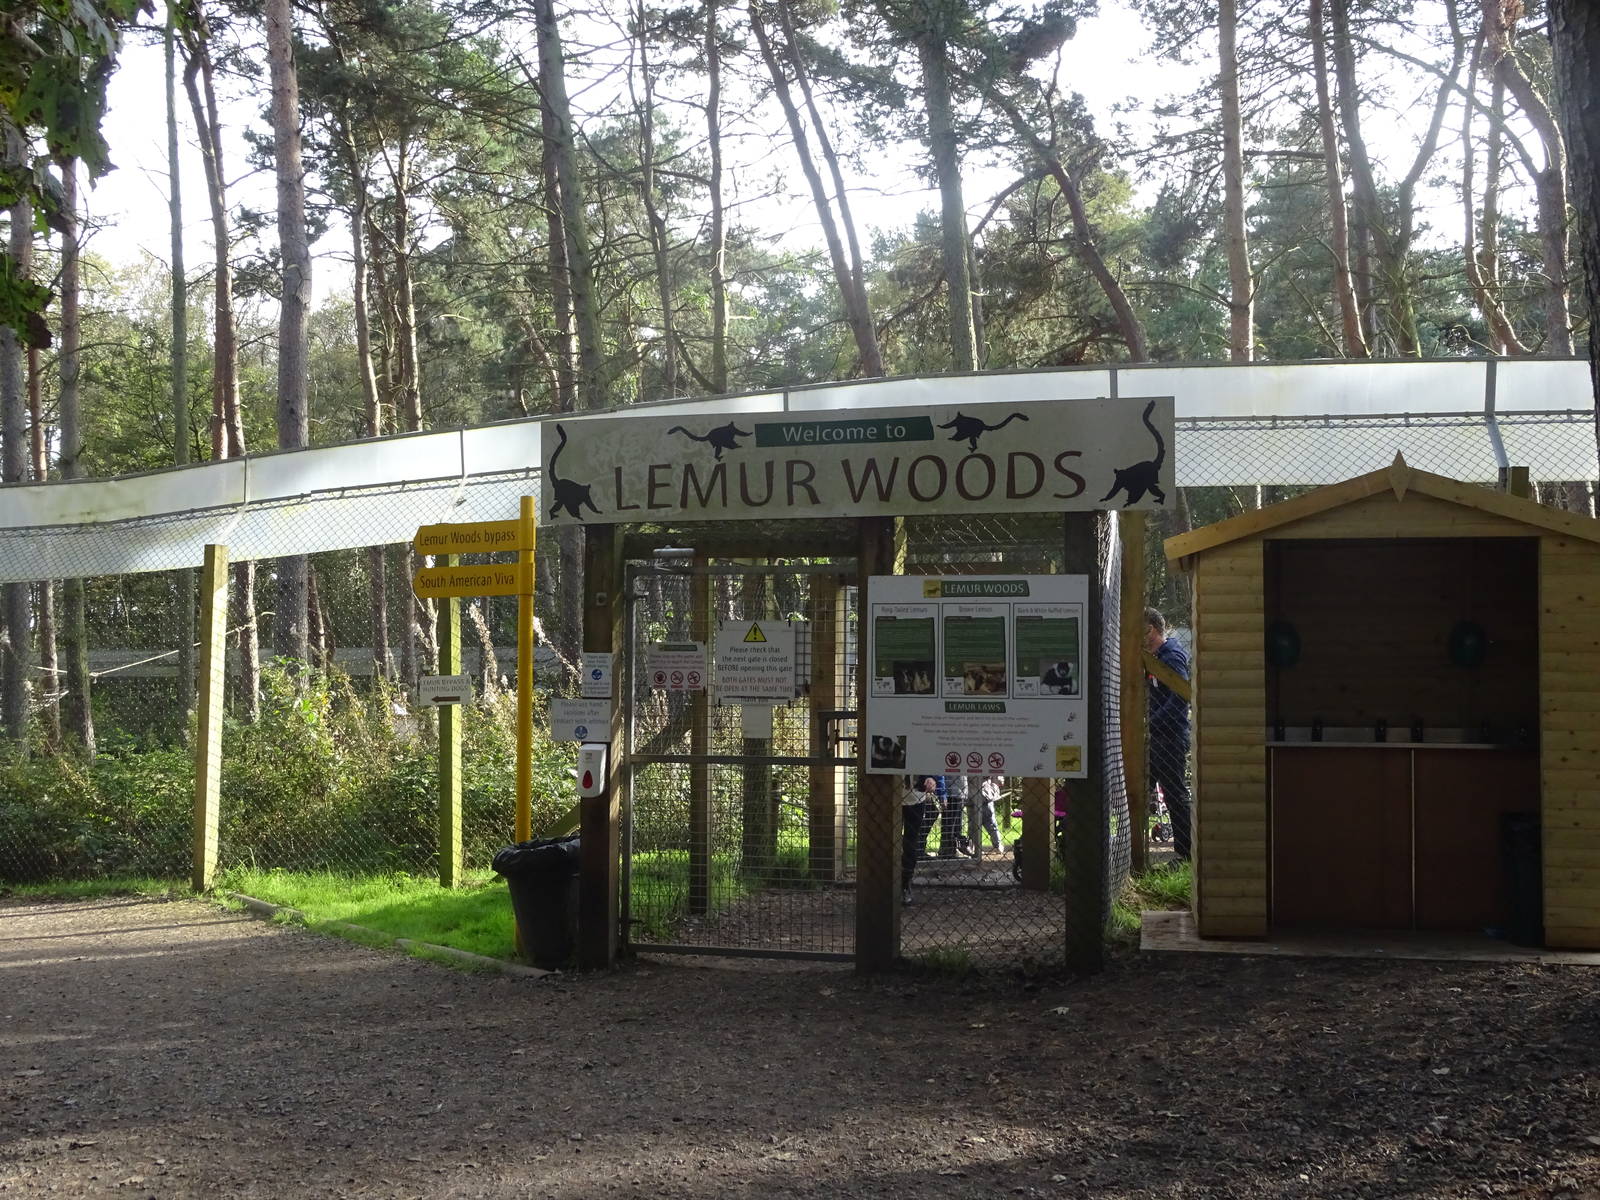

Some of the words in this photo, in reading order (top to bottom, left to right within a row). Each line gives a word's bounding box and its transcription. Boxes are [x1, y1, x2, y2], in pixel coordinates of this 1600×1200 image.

[782, 425, 877, 442] Welcome
[886, 424, 906, 439] to
[614, 459, 821, 511] LEMUR
[841, 450, 1086, 503] WOODS
[420, 533, 449, 546] Lemur
[450, 531, 481, 544] Woods
[485, 529, 516, 545] bypass
[420, 575, 446, 588] South
[448, 574, 492, 587] American
[494, 572, 514, 585] Viva
[944, 584, 981, 594] LEMUR
[983, 583, 1025, 593] WOODS
[949, 703, 976, 711] LEMUR
[977, 703, 1001, 711] LAWS
